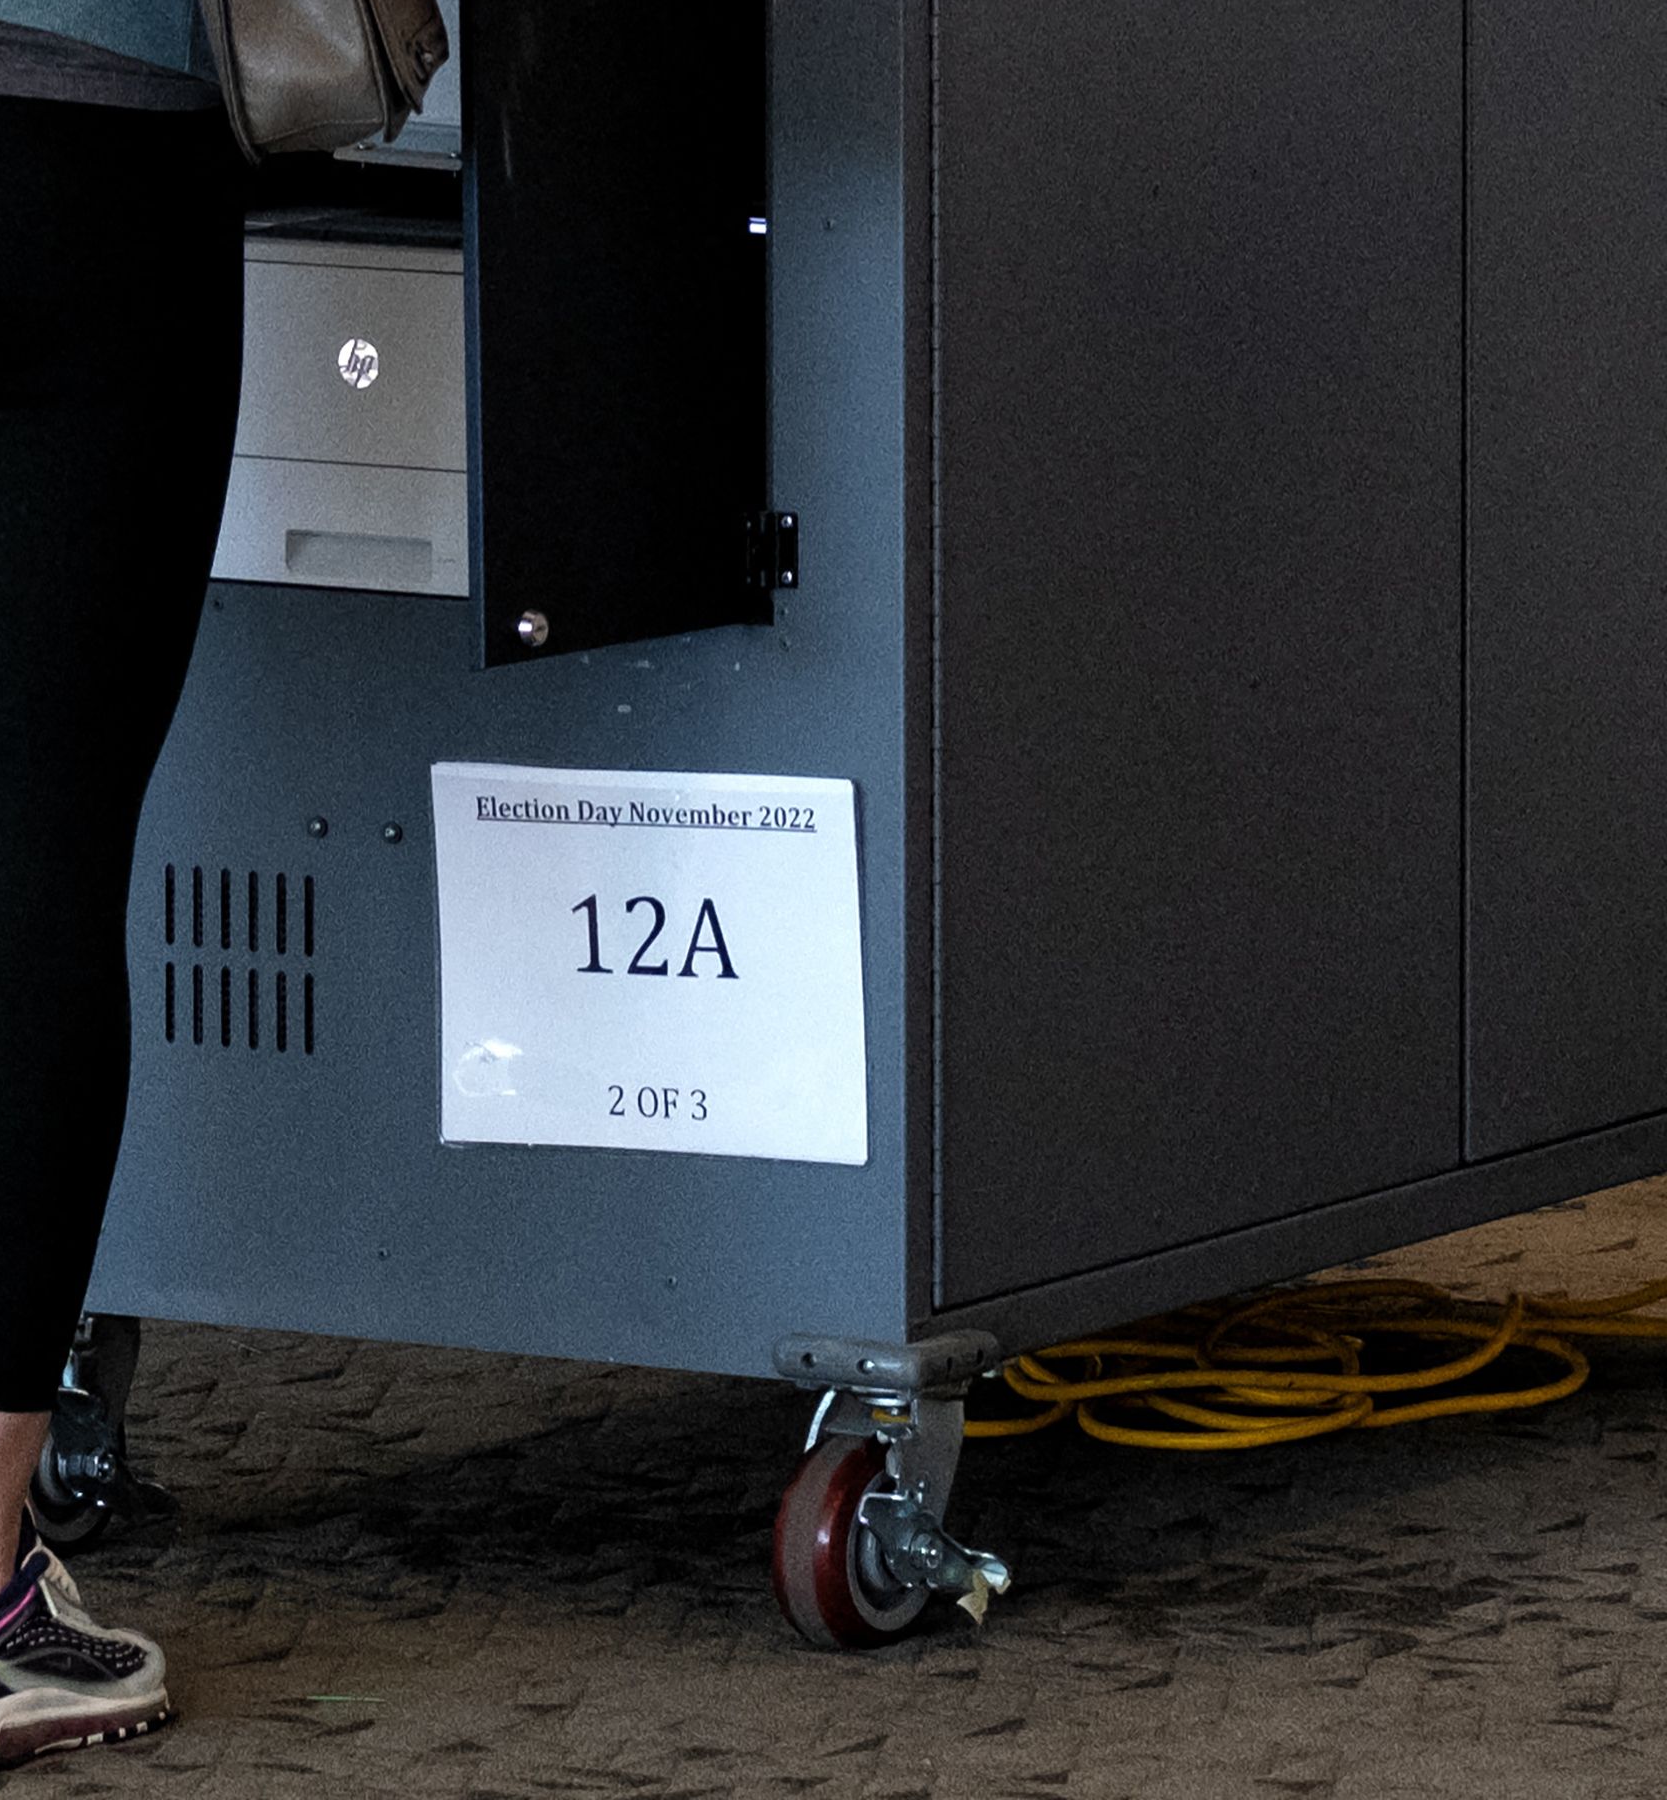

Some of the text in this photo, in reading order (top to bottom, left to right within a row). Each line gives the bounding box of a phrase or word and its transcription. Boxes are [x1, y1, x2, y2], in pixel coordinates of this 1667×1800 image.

[338, 339, 379, 389] hp
[476, 796, 817, 830] Election Day November 2022
[571, 893, 739, 979] 12A
[608, 1085, 708, 1120] 2 OF 3
